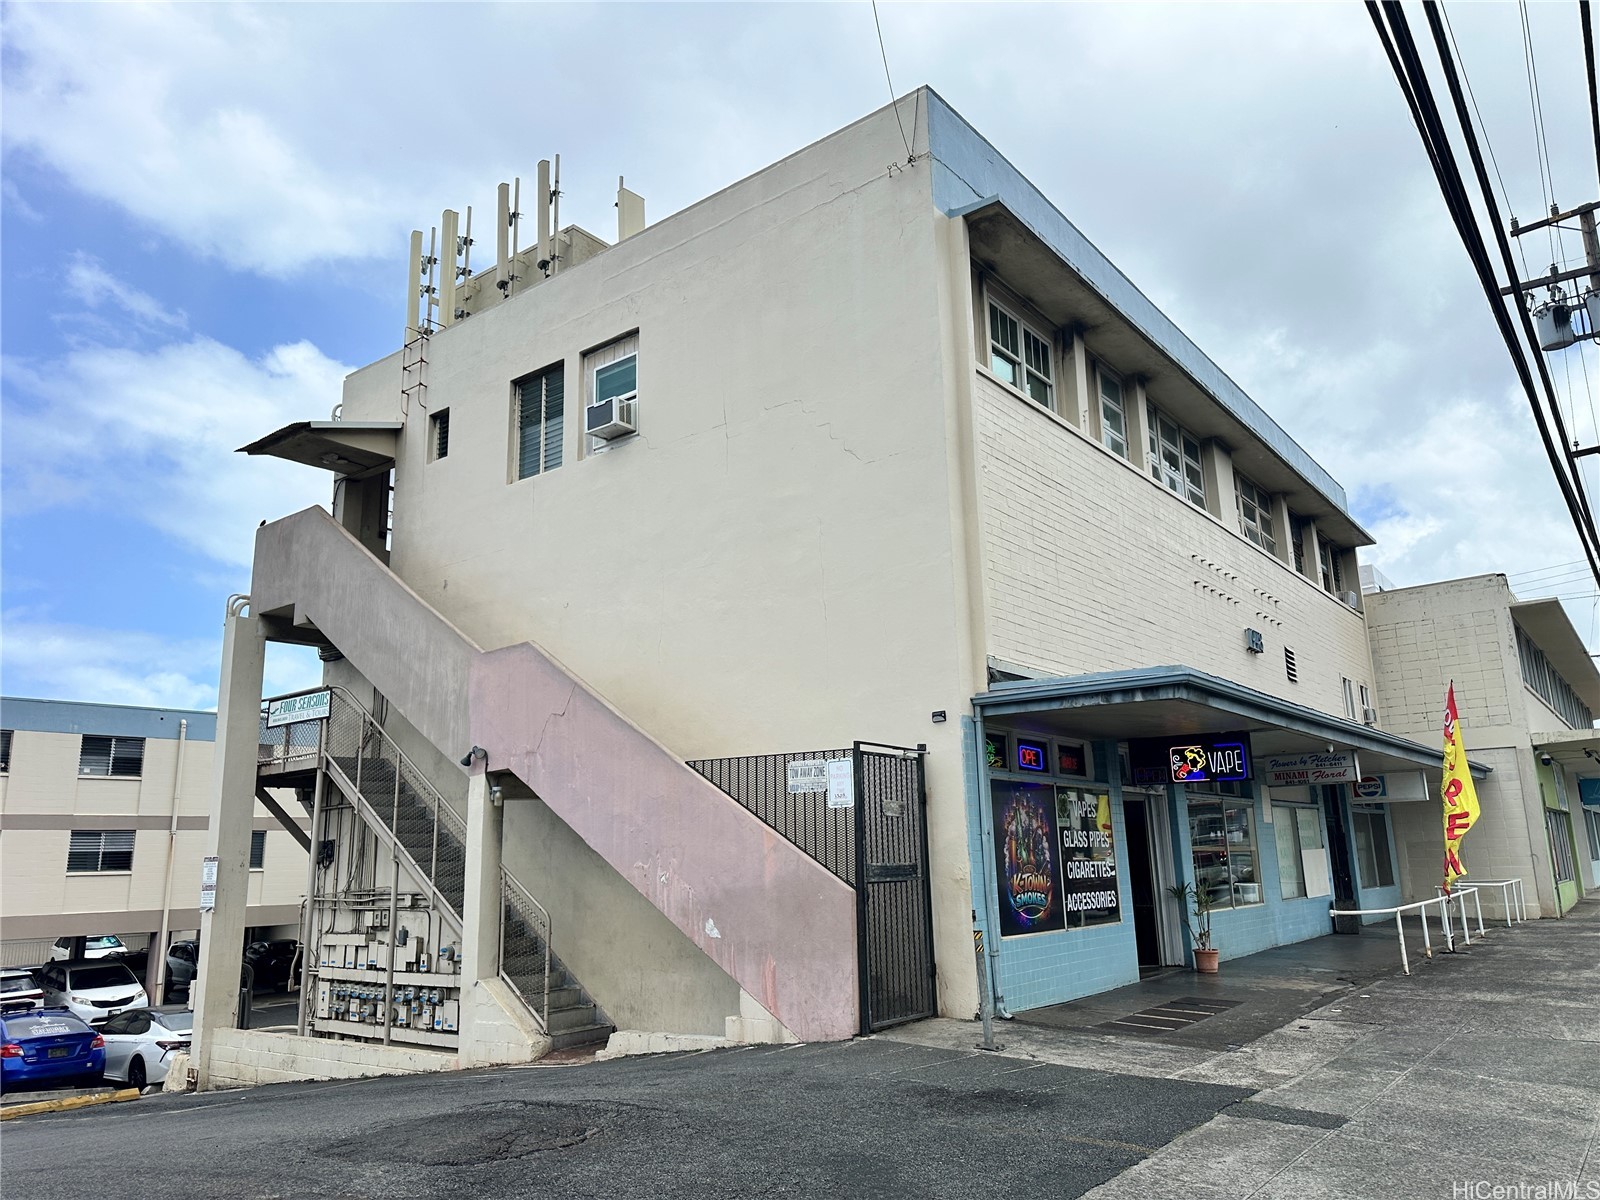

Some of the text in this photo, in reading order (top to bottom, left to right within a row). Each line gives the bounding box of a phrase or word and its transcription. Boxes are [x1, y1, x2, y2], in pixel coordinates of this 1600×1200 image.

[280, 692, 329, 713] FOUR SEASONS
[1207, 750, 1243, 773] VAPE
[1270, 754, 1348, 769] Flowers by Fletcher
[813, 766, 825, 777] ZONE
[1274, 769, 1347, 781] MINAMI Floral
[1073, 801, 1097, 818] VAPES
[1063, 830, 1110, 848] GLASS PIPES
[1067, 861, 1111, 879] CIGARETTES
[1016, 892, 1047, 907] SMOKES
[1067, 890, 1117, 912] ACCESSORIES
